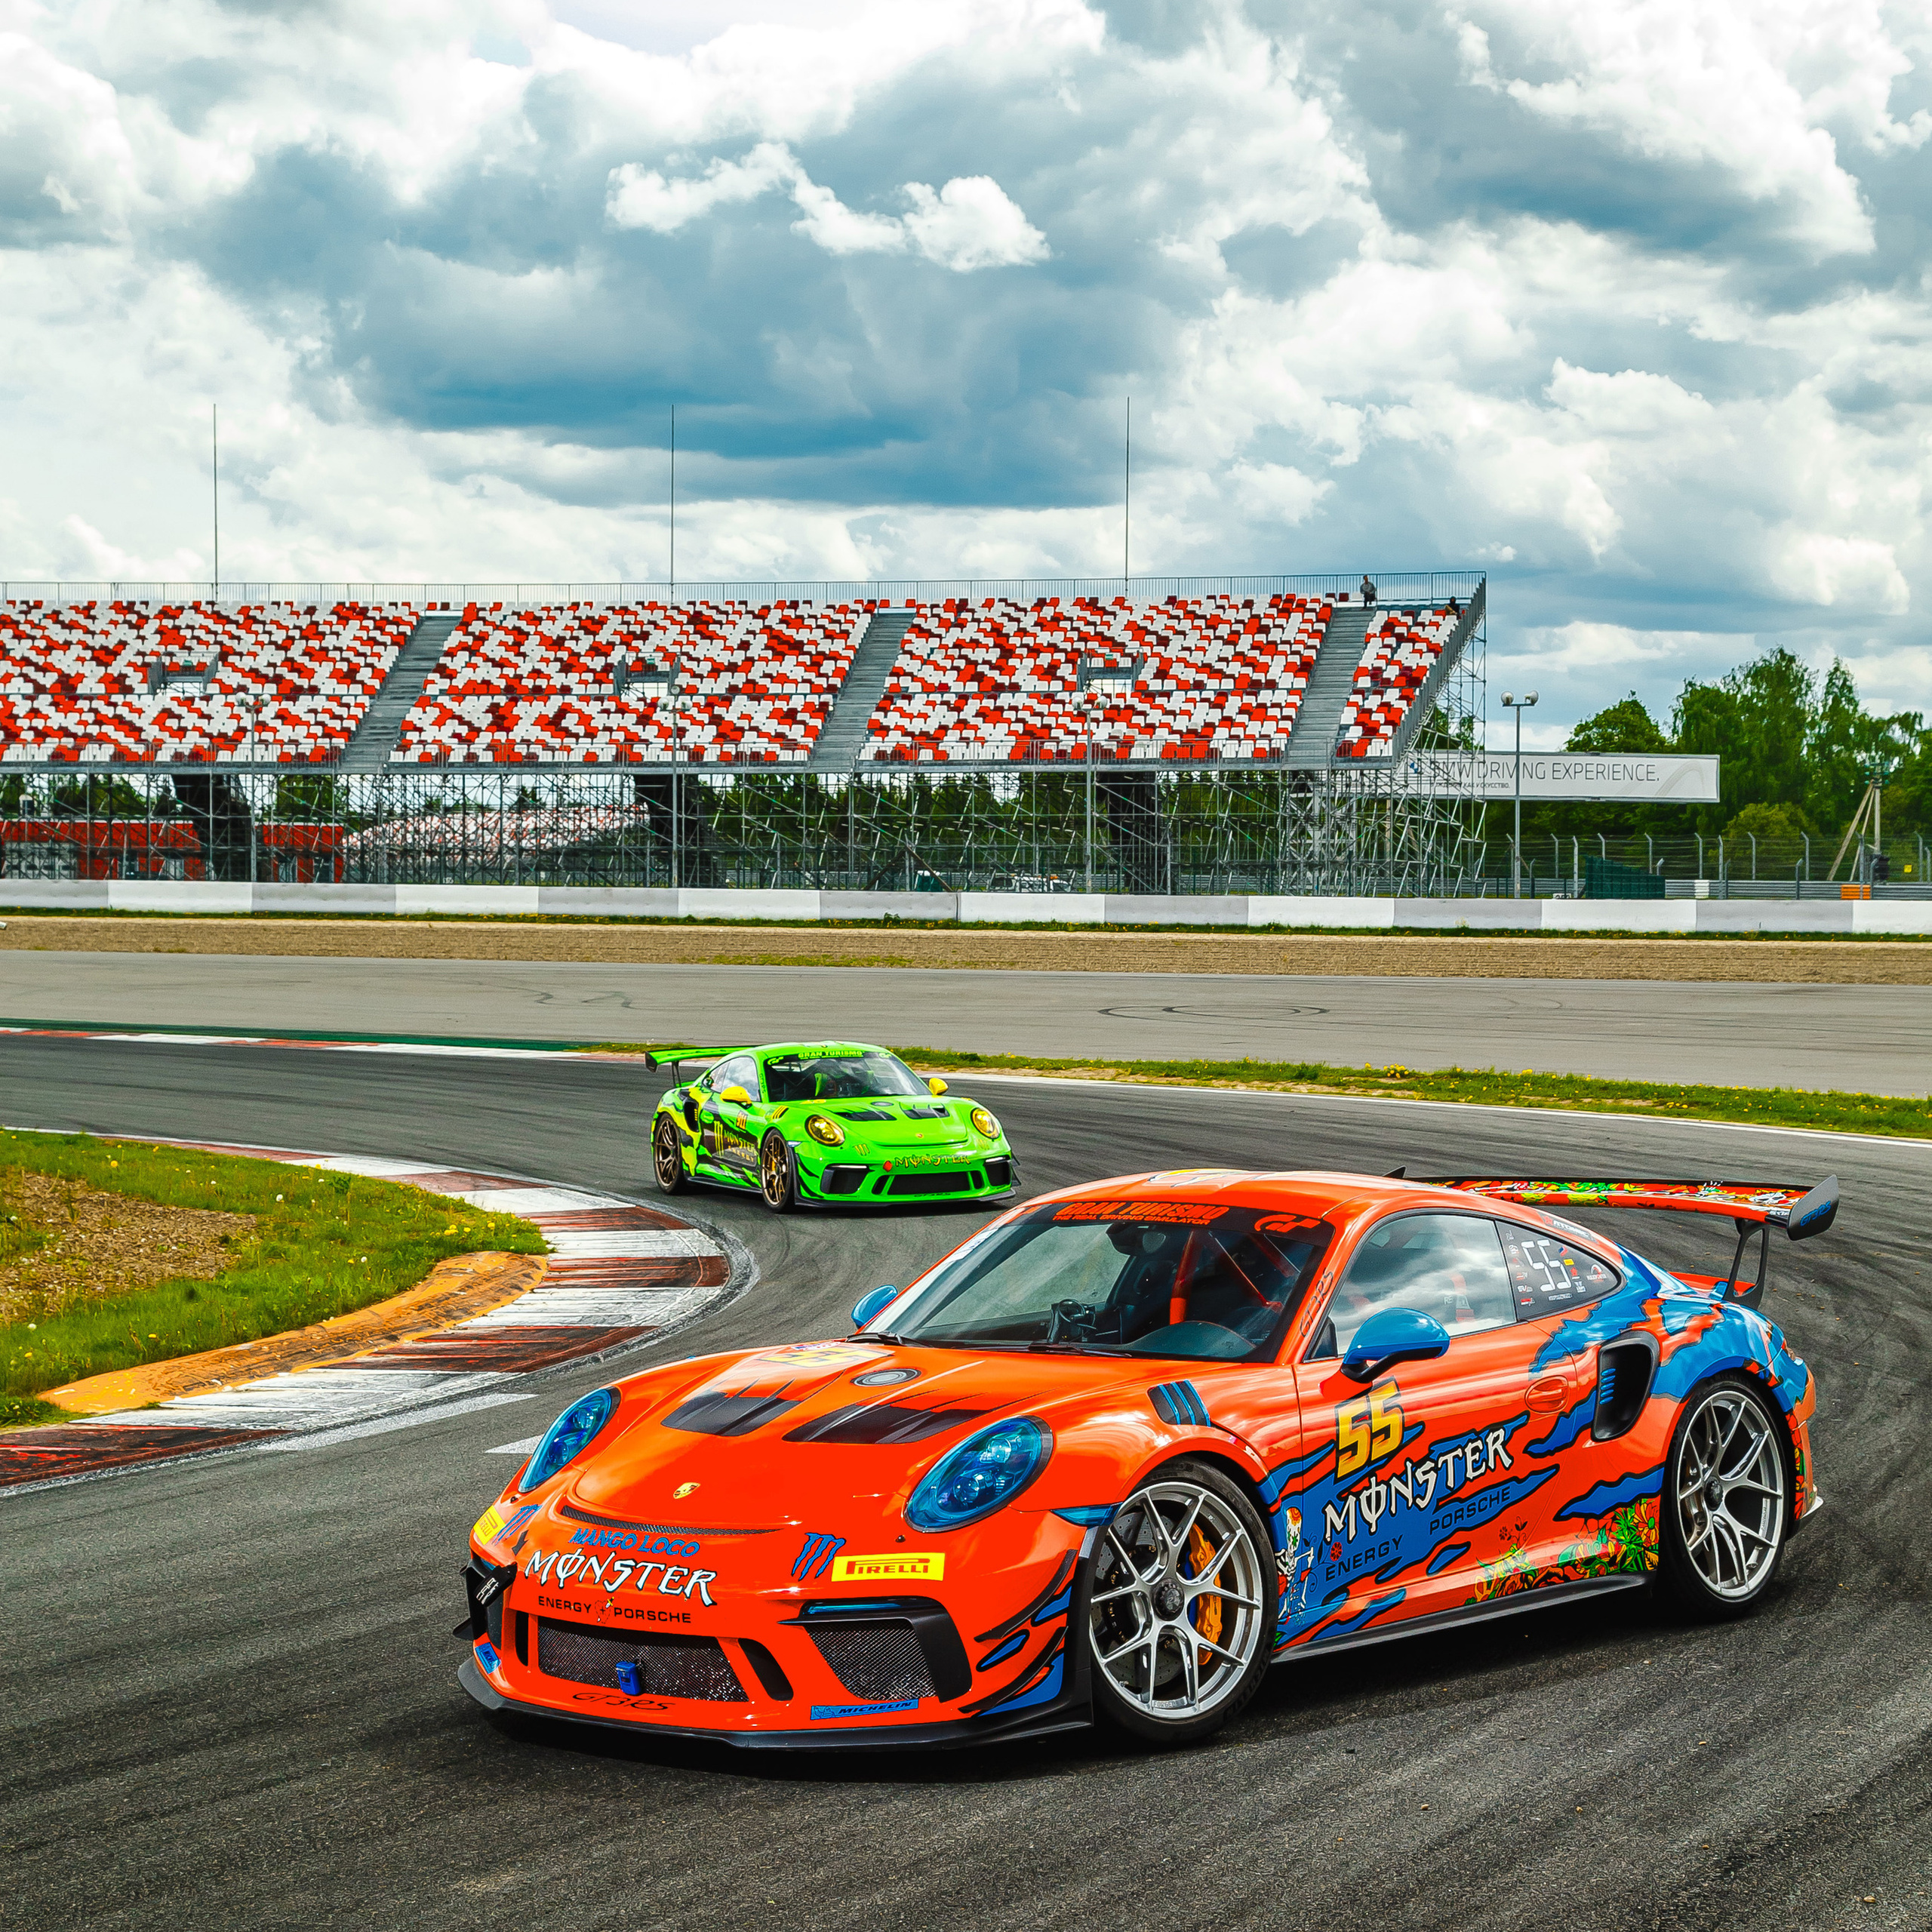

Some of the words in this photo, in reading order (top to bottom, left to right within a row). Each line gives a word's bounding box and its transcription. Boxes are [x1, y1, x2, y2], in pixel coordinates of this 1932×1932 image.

[1477, 761, 1546, 780] DRIVNG
[1552, 762, 1660, 781] EXPERIENCE.
[1057, 1201, 1127, 1216] GRAN
[1124, 1202, 1230, 1220] TURISMO
[1143, 1216, 1211, 1226] SIMULATOR
[1521, 1239, 1572, 1292] 55
[1334, 1377, 1404, 1478] 55
[1324, 1428, 1513, 1543] MONSTER
[568, 1528, 637, 1550] MANGO
[637, 1535, 700, 1558] LOCO
[1325, 1534, 1403, 1582] ENERGY
[1429, 1486, 1511, 1535] PORSCHE
[524, 1548, 717, 1607] MONSTER
[846, 1558, 931, 1575] PIRELLI
[538, 1596, 592, 1614] ENERGY
[614, 1607, 691, 1623] PORSCHE
[838, 1701, 912, 1714] MICHELIN
